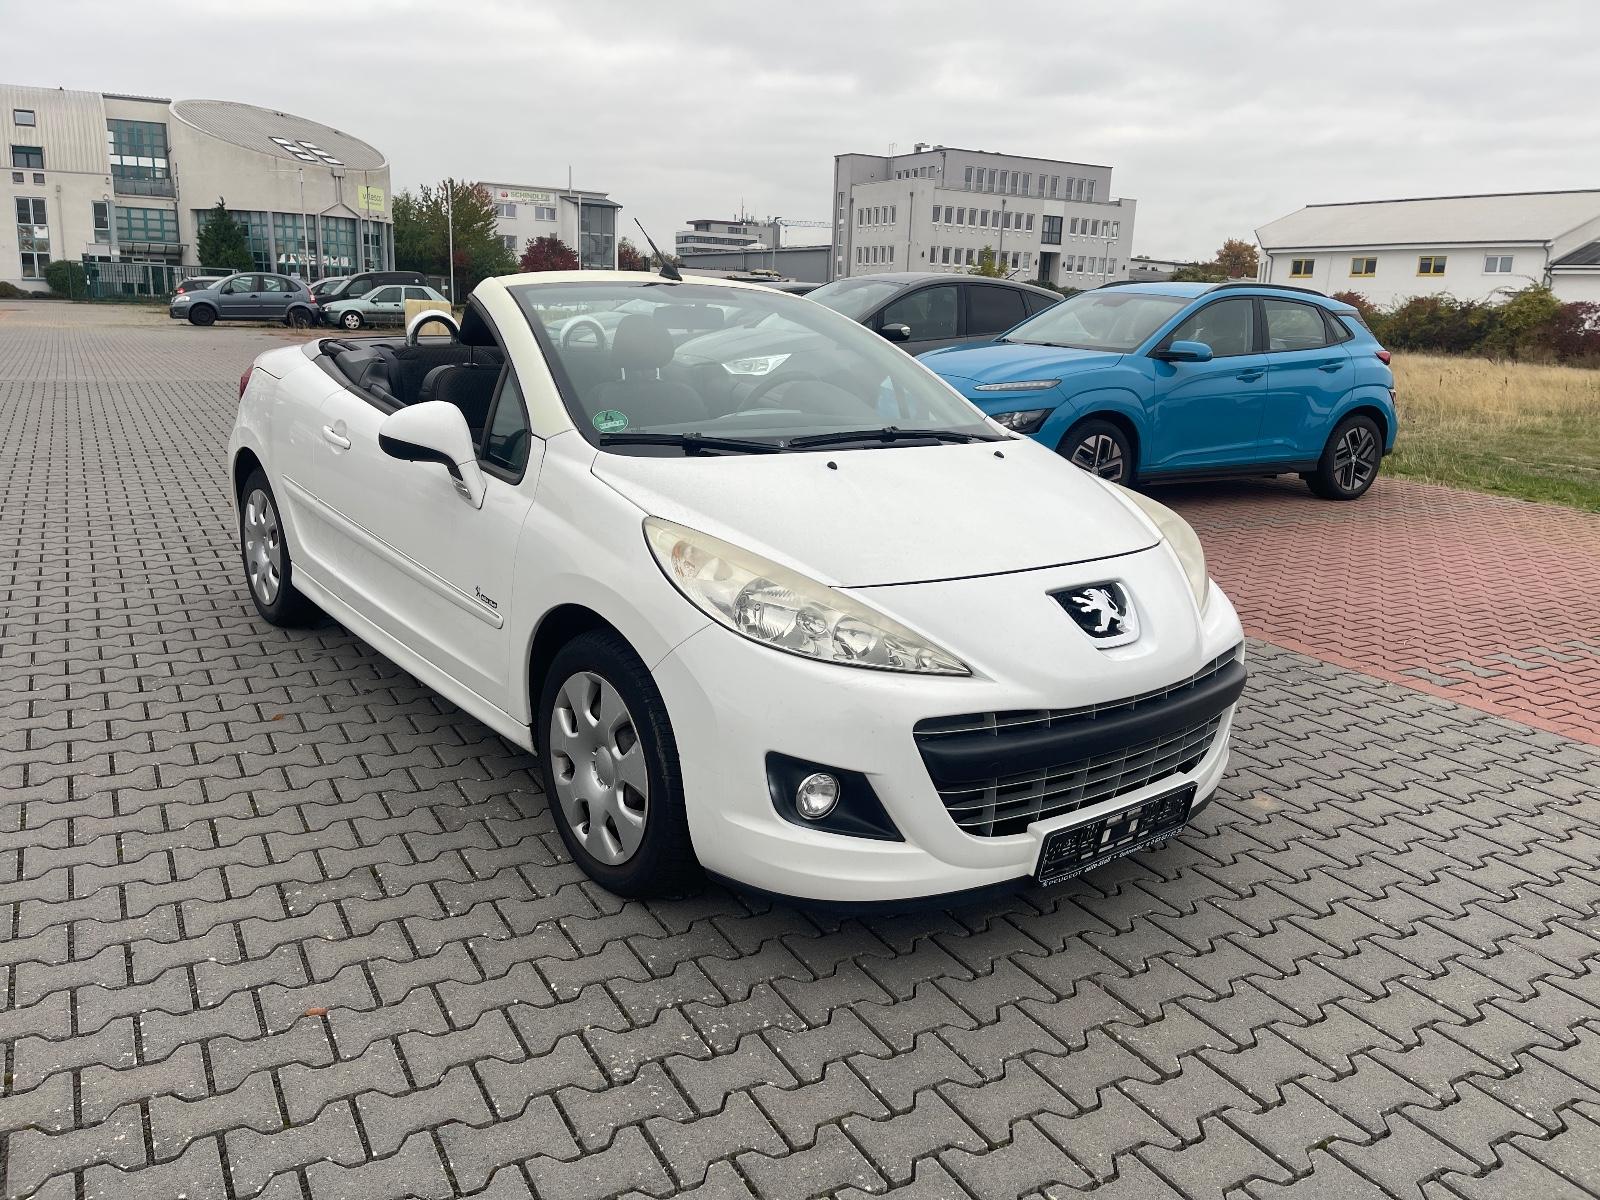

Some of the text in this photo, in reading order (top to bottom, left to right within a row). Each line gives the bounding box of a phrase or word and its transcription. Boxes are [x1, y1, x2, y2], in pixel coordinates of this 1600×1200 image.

[510, 191, 550, 201] SCHINDLER
[604, 411, 614, 422] 4
[1048, 870, 1082, 886] PEUGEOT
